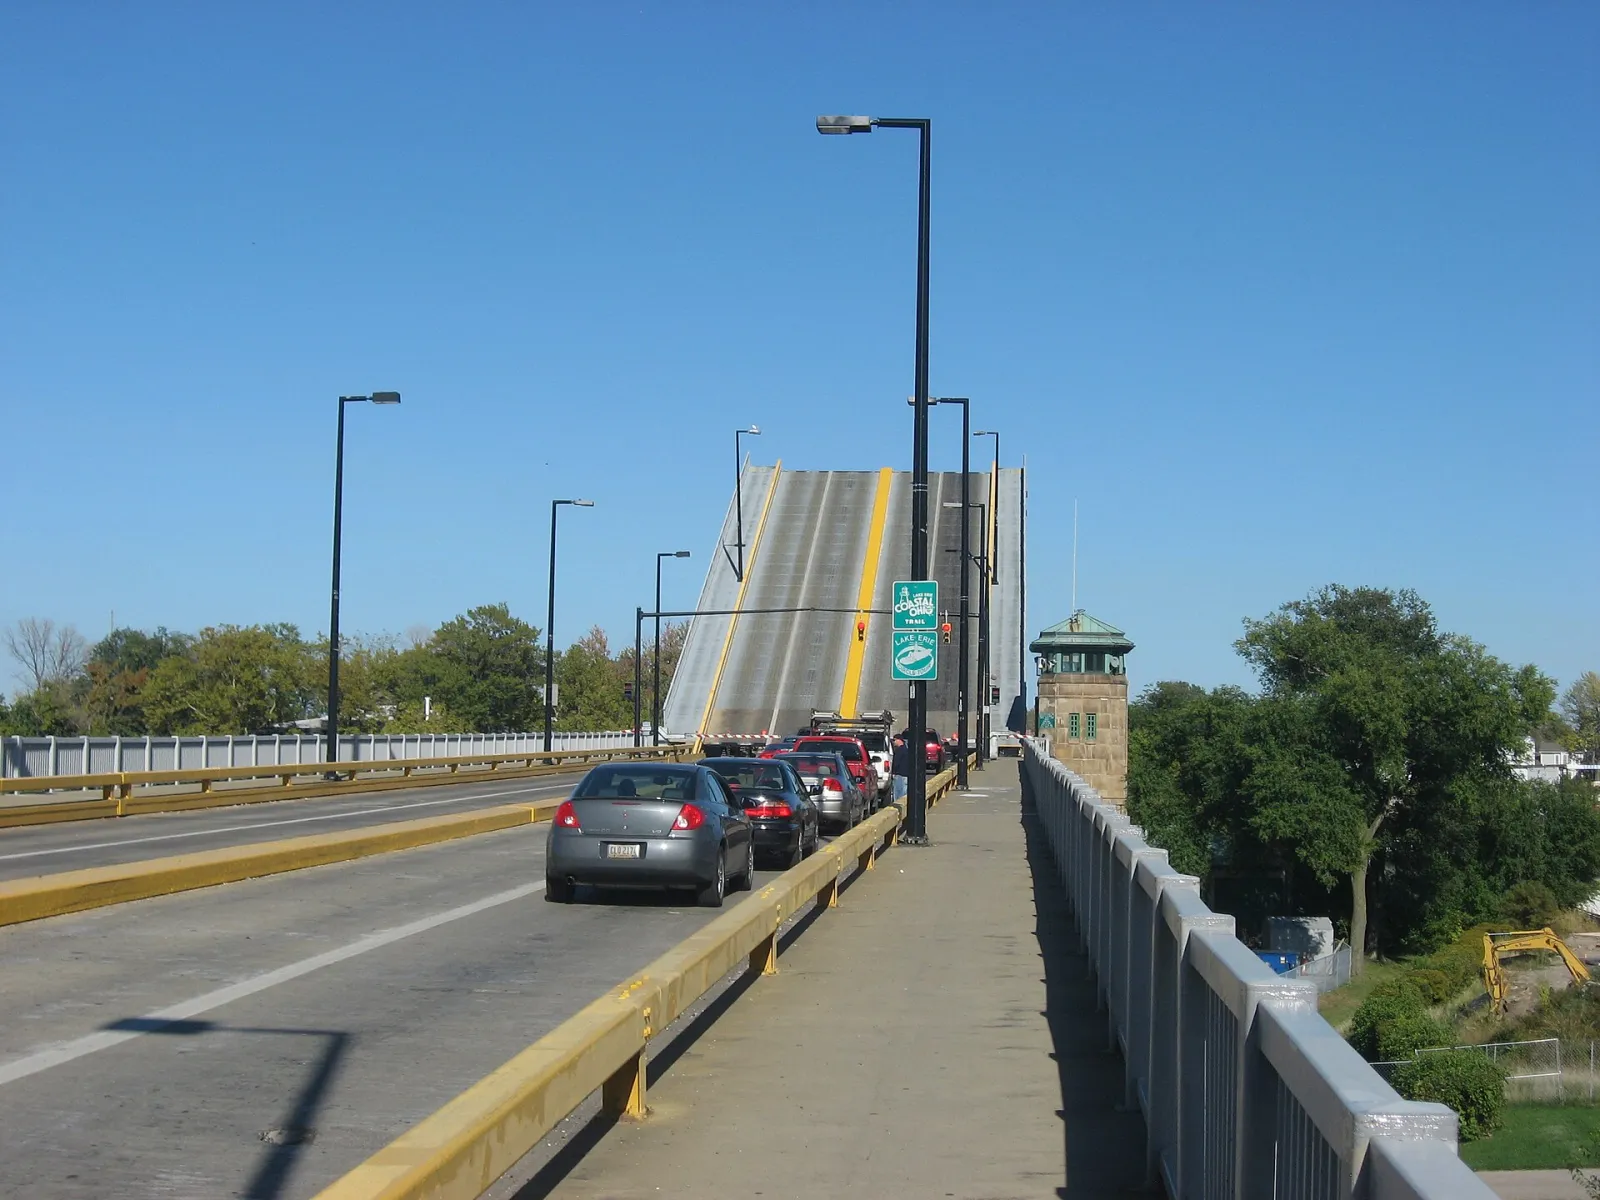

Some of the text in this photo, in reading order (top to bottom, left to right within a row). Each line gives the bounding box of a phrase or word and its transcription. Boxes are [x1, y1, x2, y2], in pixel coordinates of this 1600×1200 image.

[894, 597, 934, 613] COASTAL
[909, 605, 934, 617] OHIO
[894, 634, 935, 646] LAKE ERIE
